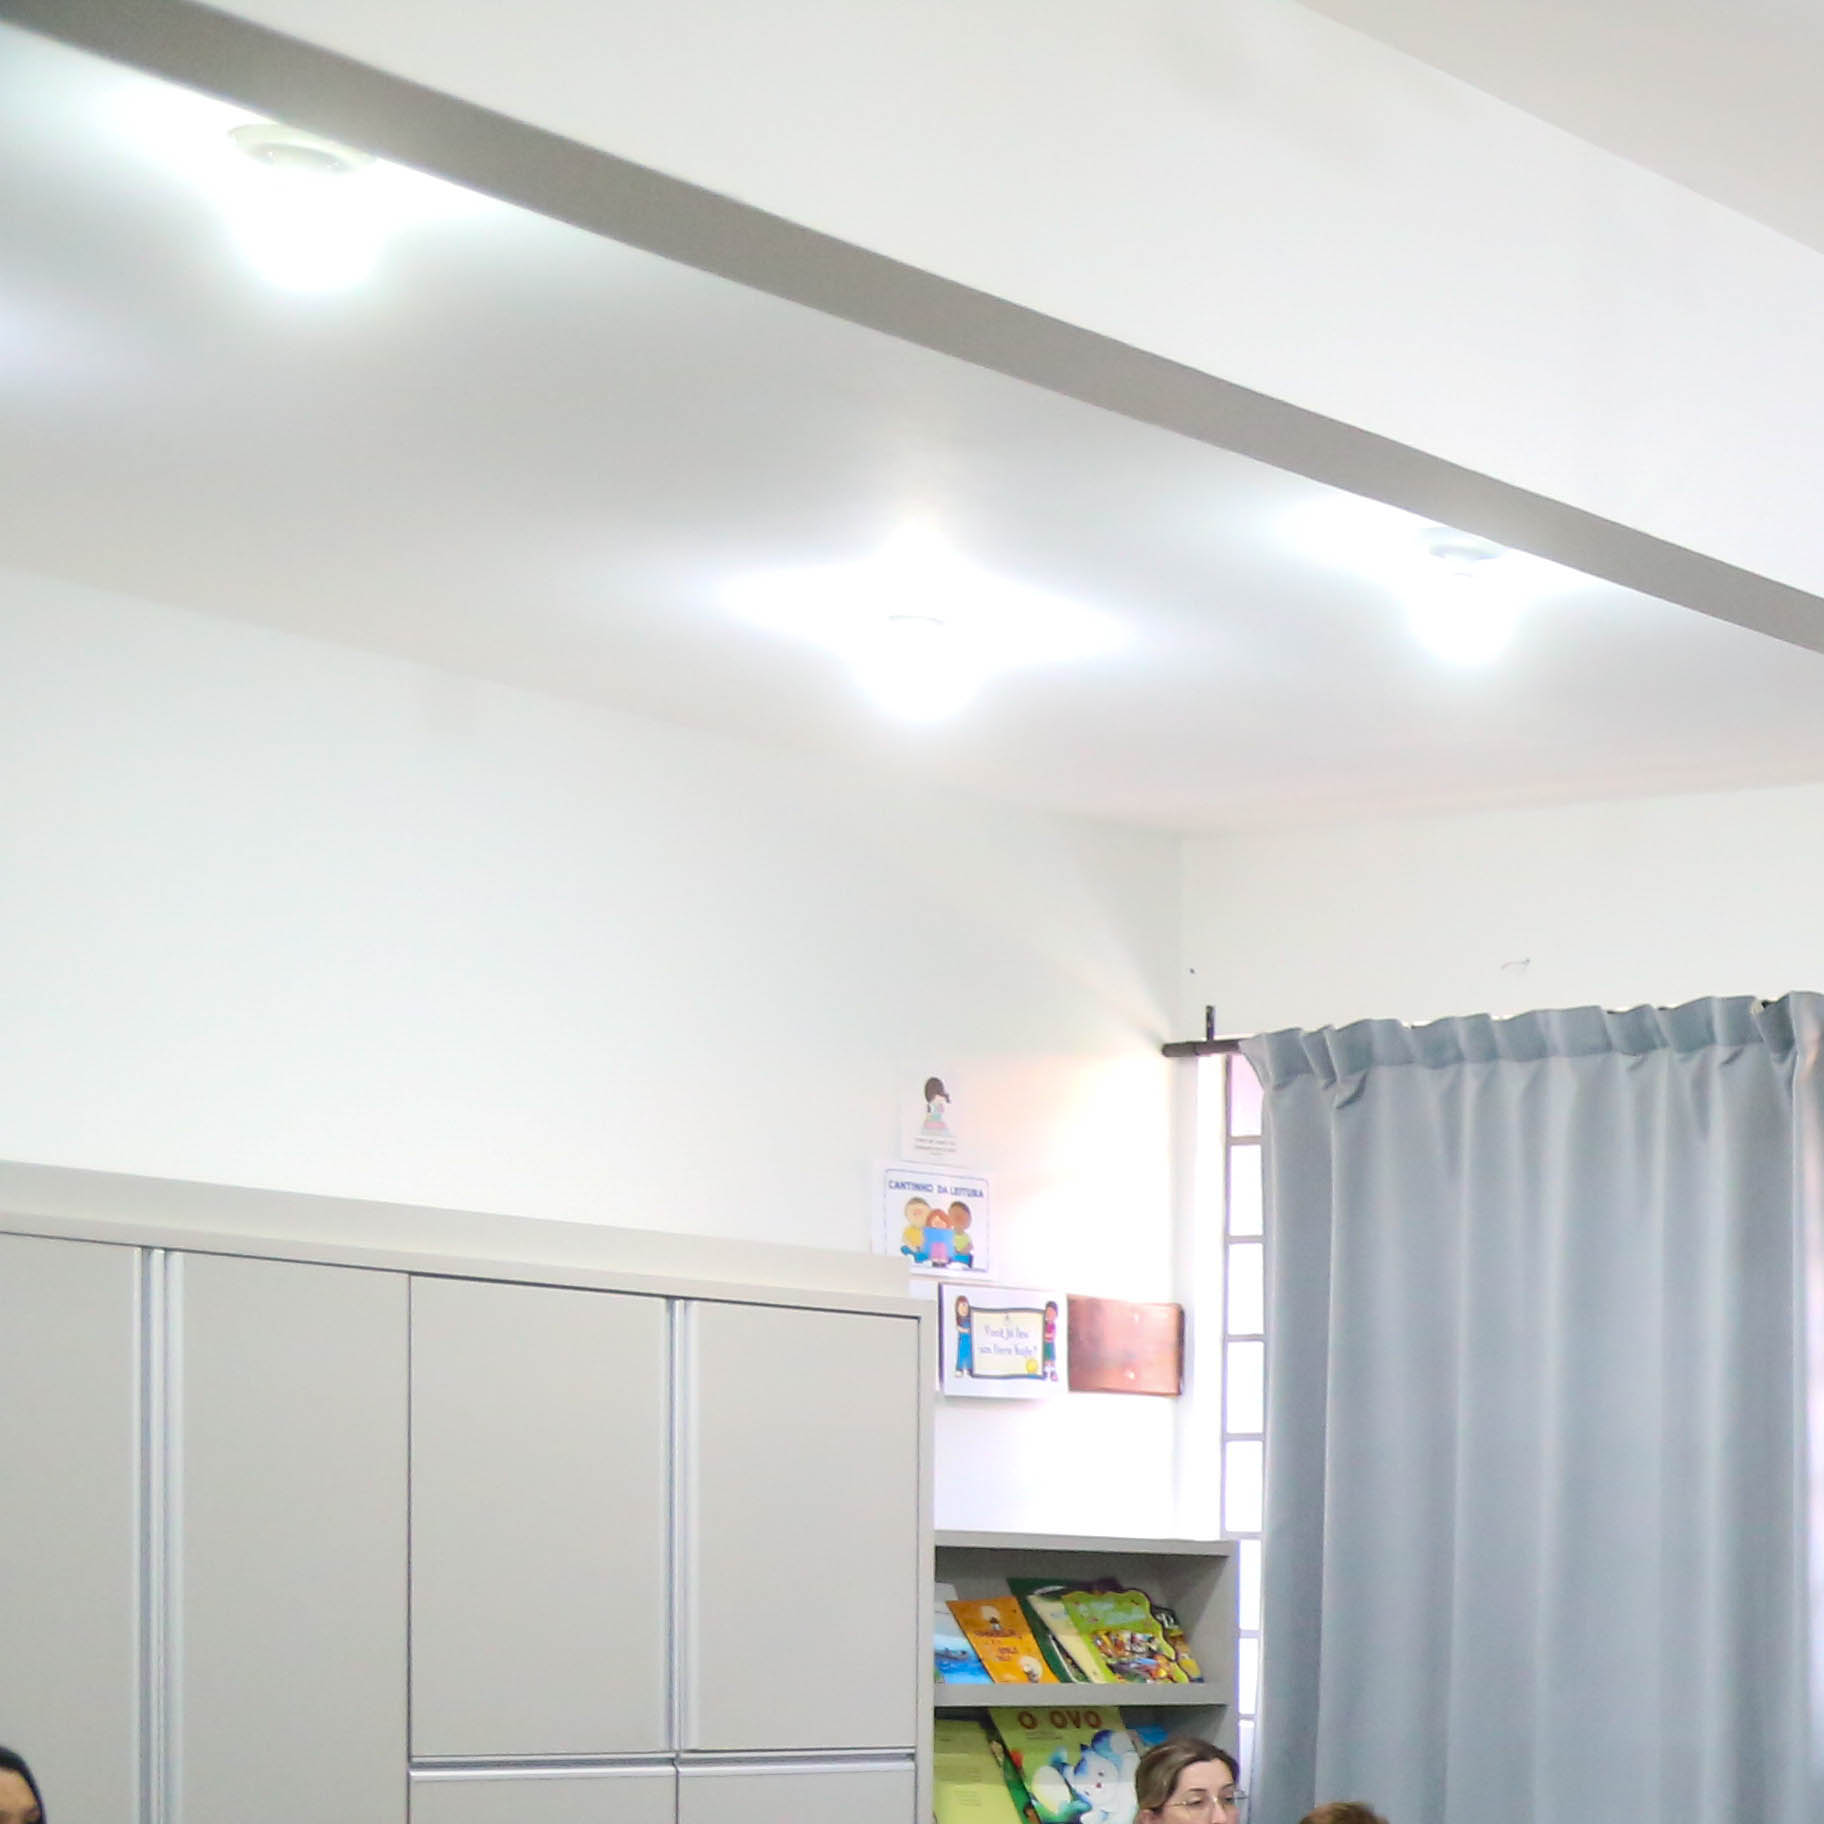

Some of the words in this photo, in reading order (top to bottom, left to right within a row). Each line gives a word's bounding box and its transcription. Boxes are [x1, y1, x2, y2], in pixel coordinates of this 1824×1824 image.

[888, 1179, 934, 1193] CANTINHO
[937, 1185, 948, 1194] DA
[950, 1186, 984, 1198] LEITURA
[1018, 1710, 1038, 1730] O
[1049, 1709, 1102, 1730] OVO
